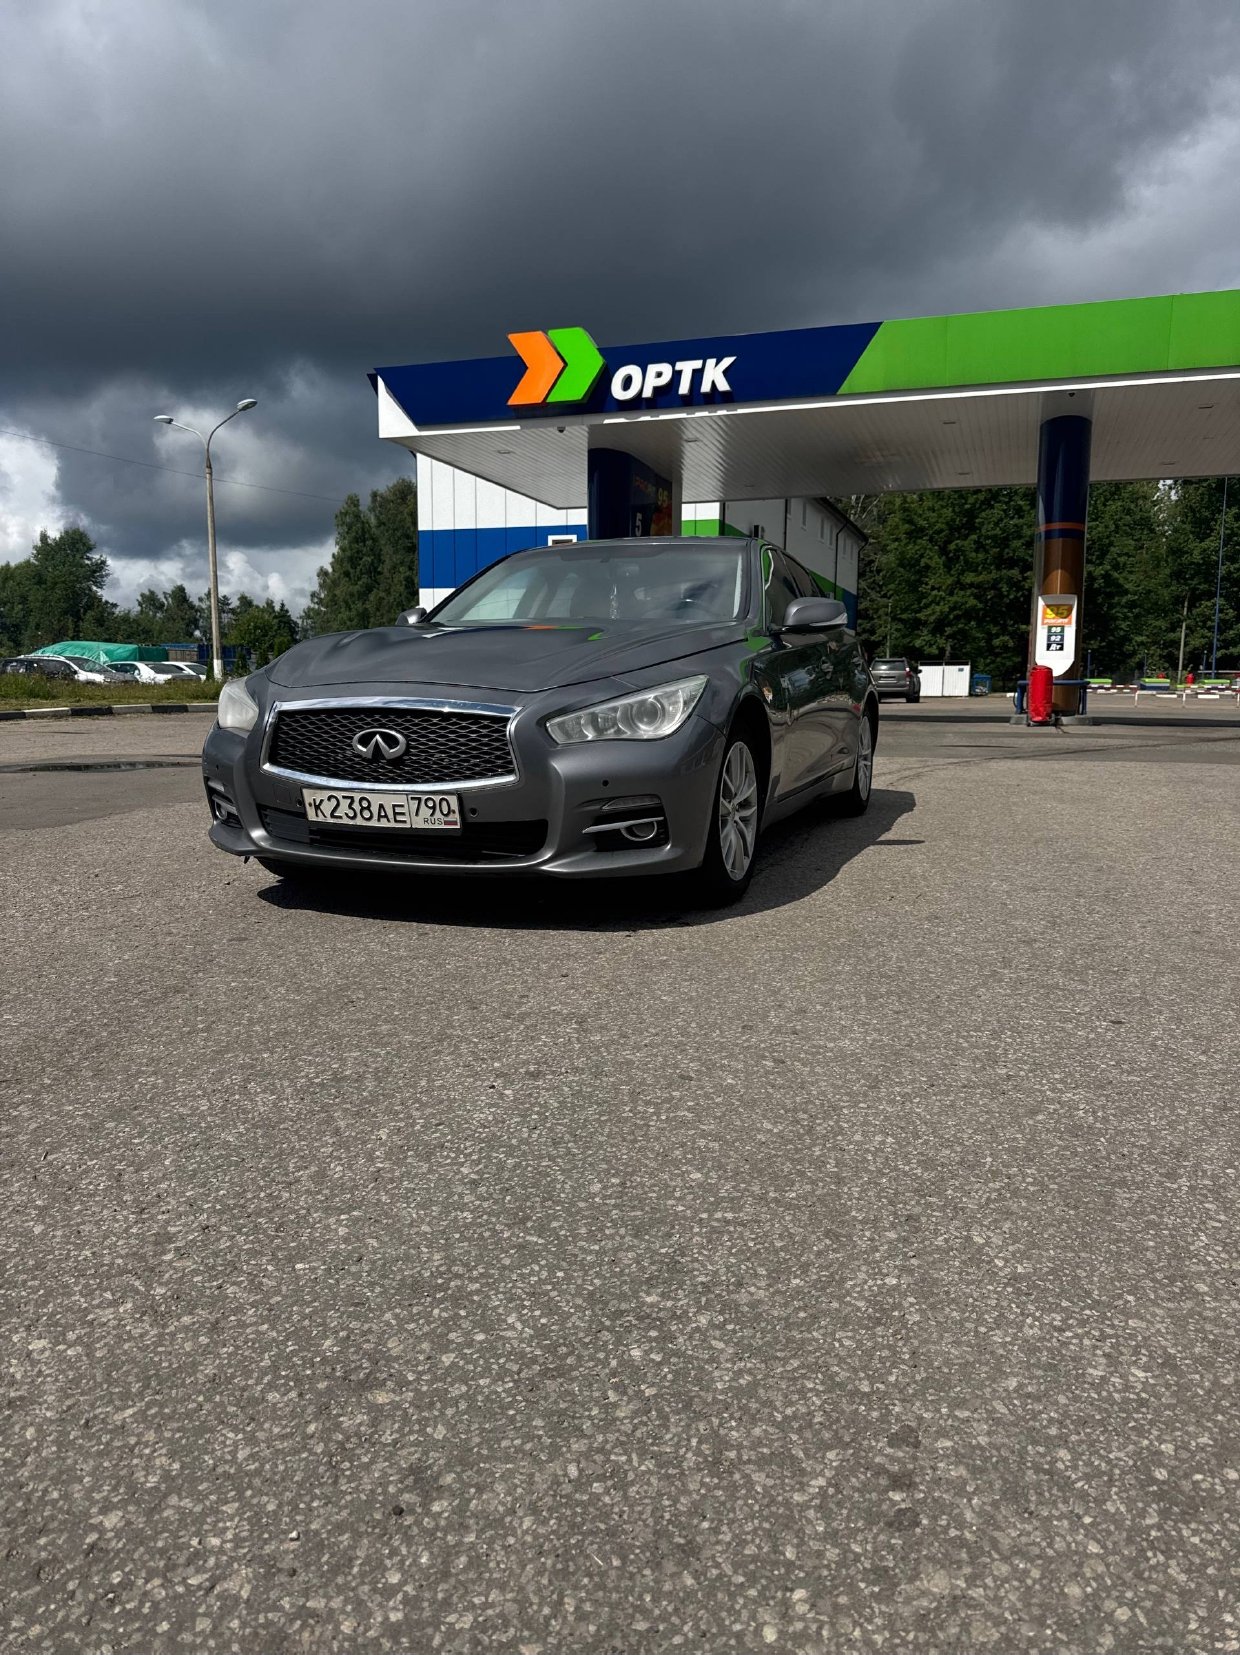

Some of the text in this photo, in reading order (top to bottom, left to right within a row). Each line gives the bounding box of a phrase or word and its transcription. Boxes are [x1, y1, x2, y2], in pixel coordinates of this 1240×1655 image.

[610, 356, 737, 401] ОРТК
[410, 796, 452, 818] 790
[423, 817, 443, 826] RUS
